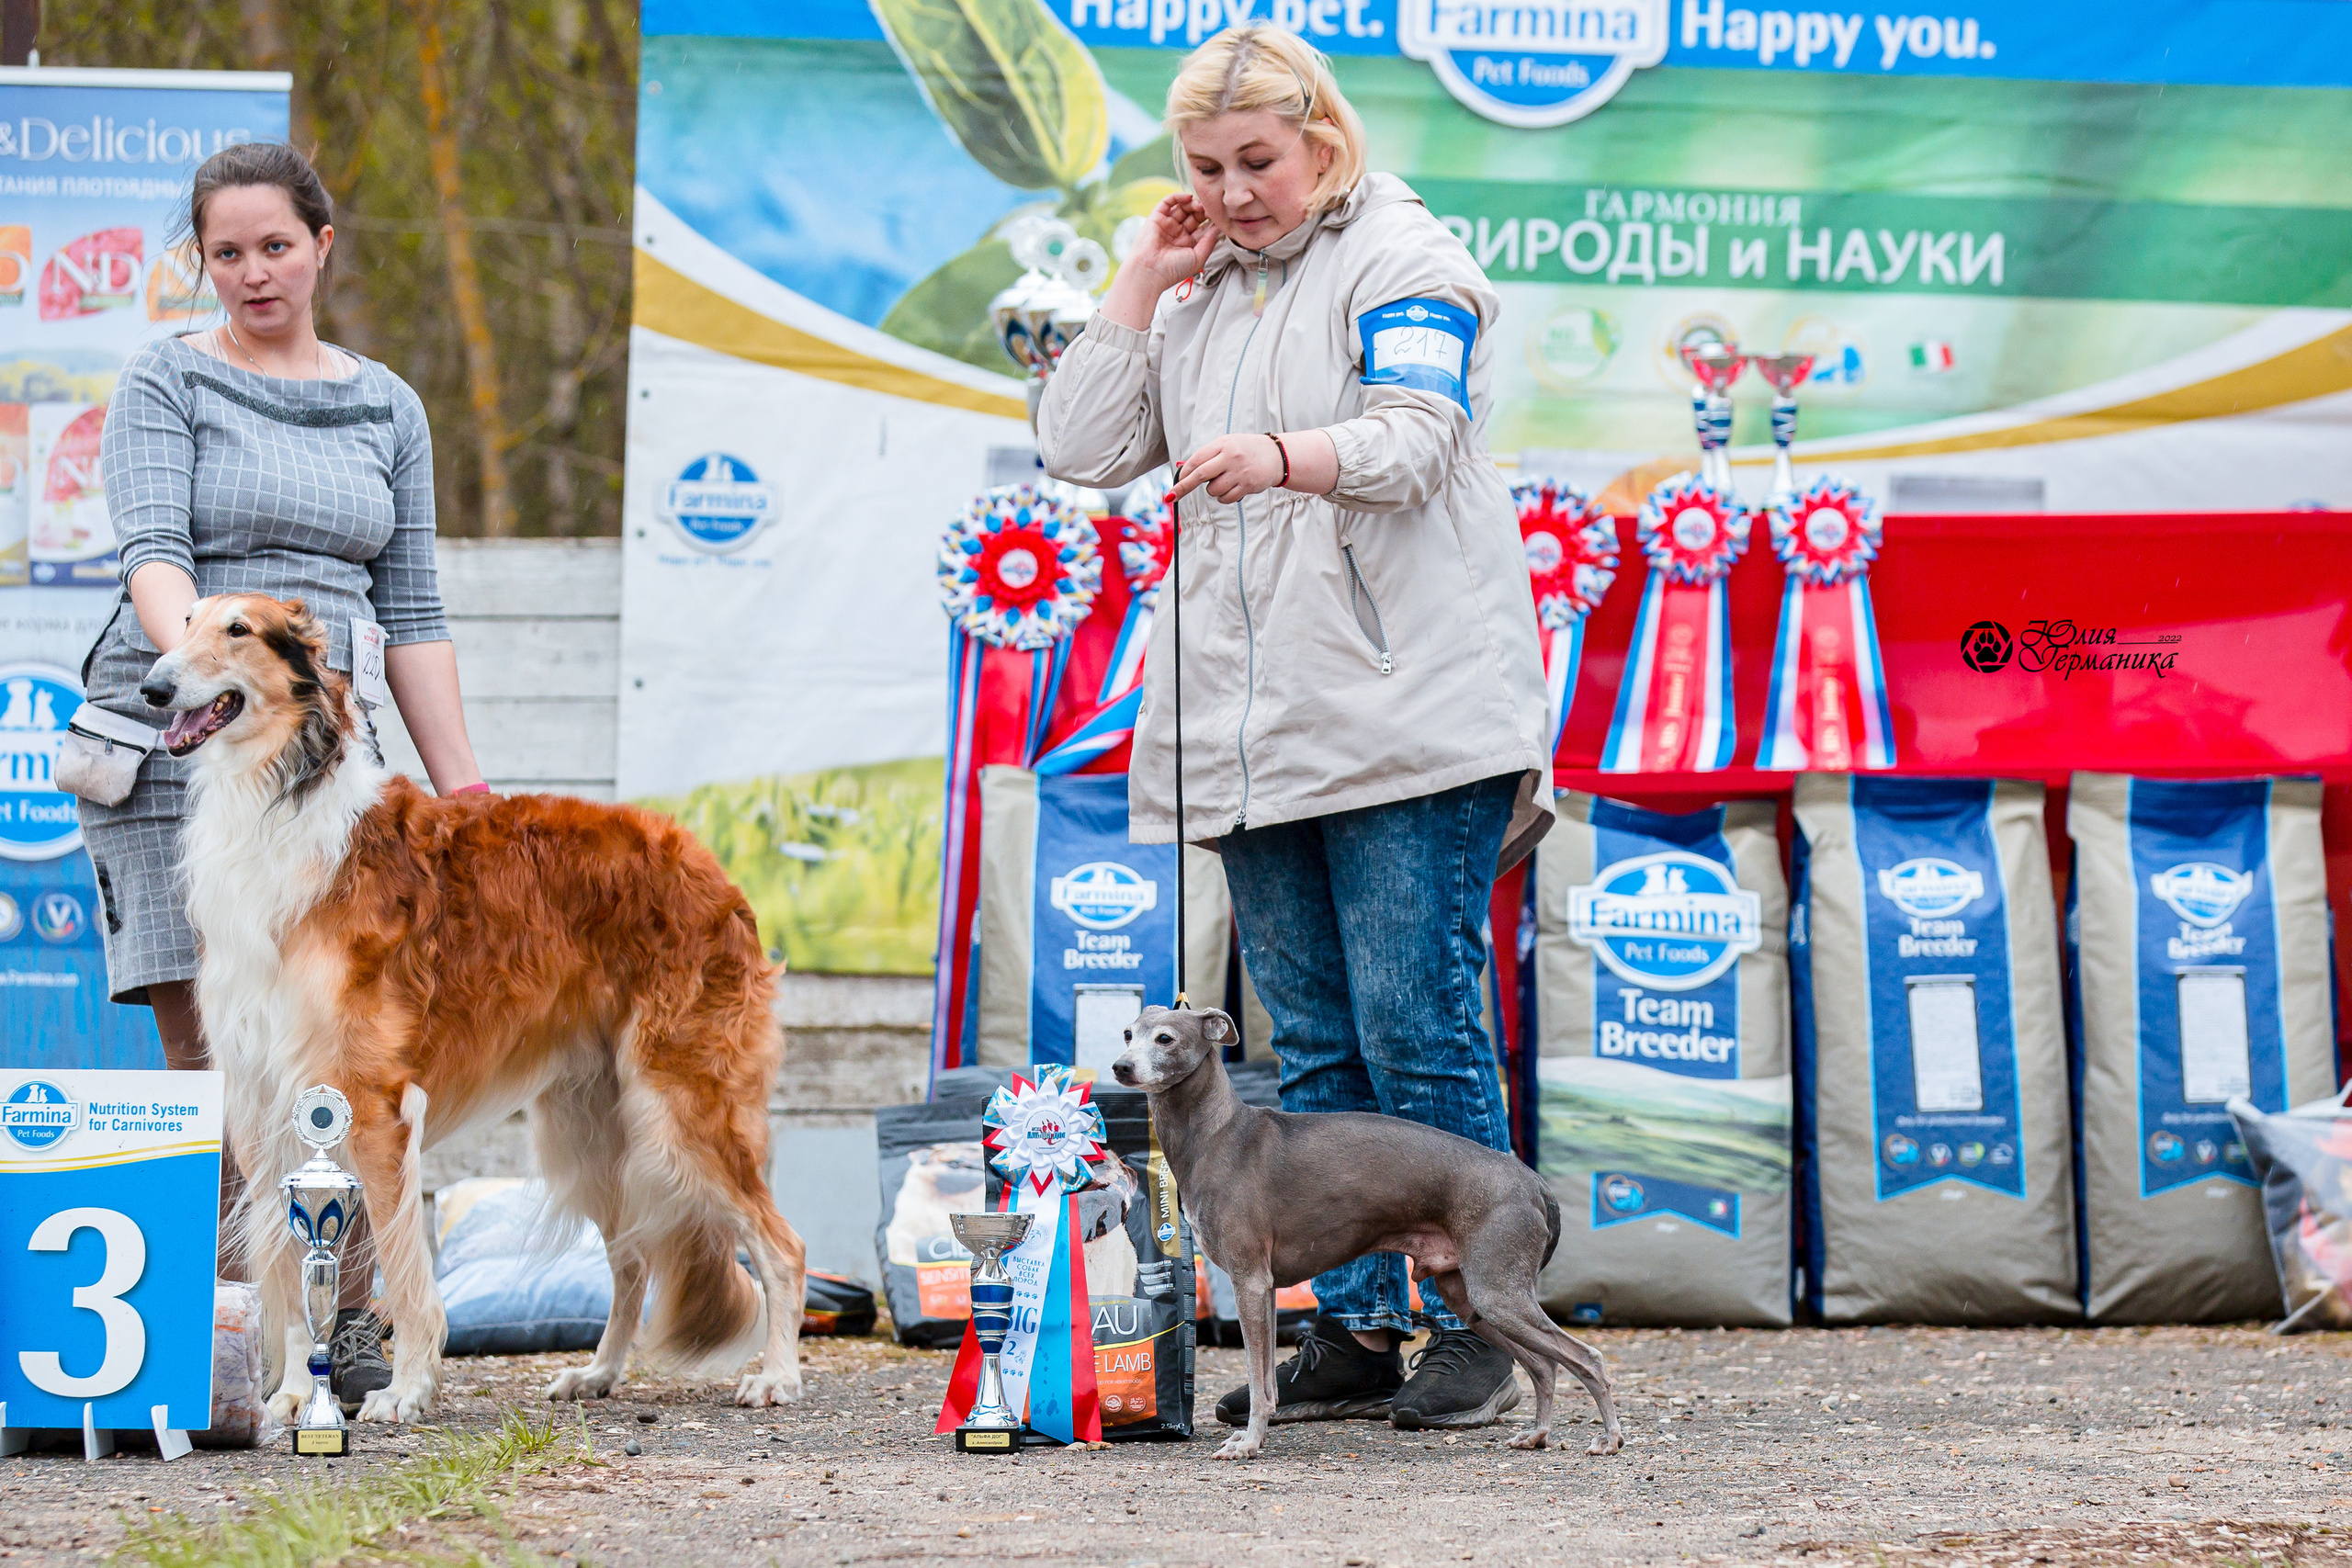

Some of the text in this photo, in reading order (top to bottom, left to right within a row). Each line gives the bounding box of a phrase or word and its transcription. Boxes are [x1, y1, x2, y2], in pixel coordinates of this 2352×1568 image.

[1681, 0, 1997, 71] Happy you.
[1585, 188, 1802, 227] ГАРМОНИЯ
[1786, 227, 2007, 287] НАУКИ
[1394, 326, 1447, 359] 217
[1590, 898, 1741, 935] Farmina
[1074, 930, 1131, 952] Team
[1063, 948, 1144, 970] Breeder
[1624, 942, 1653, 962] Pet
[1617, 987, 1715, 1030] Team
[1600, 1020, 1736, 1063] Breeder
[2, 1105, 72, 1123] Farmina
[89, 1101, 198, 1118] Nutrition System
[17, 1129, 55, 1138] Pet Foods
[89, 1118, 183, 1132] for Carnivores
[1159, 1190, 1170, 1219] MINI
[1012, 1256, 1046, 1268] ВЫСТАВКА
[1016, 1264, 1039, 1273] СОБАК
[1013, 1276, 1038, 1286] ПОРОД
[1018, 1270, 1035, 1279] ВСЕХ
[18, 1206, 146, 1398] 3
[1006, 1340, 1017, 1356] 2
[1104, 1352, 1152, 1373] LAMB
